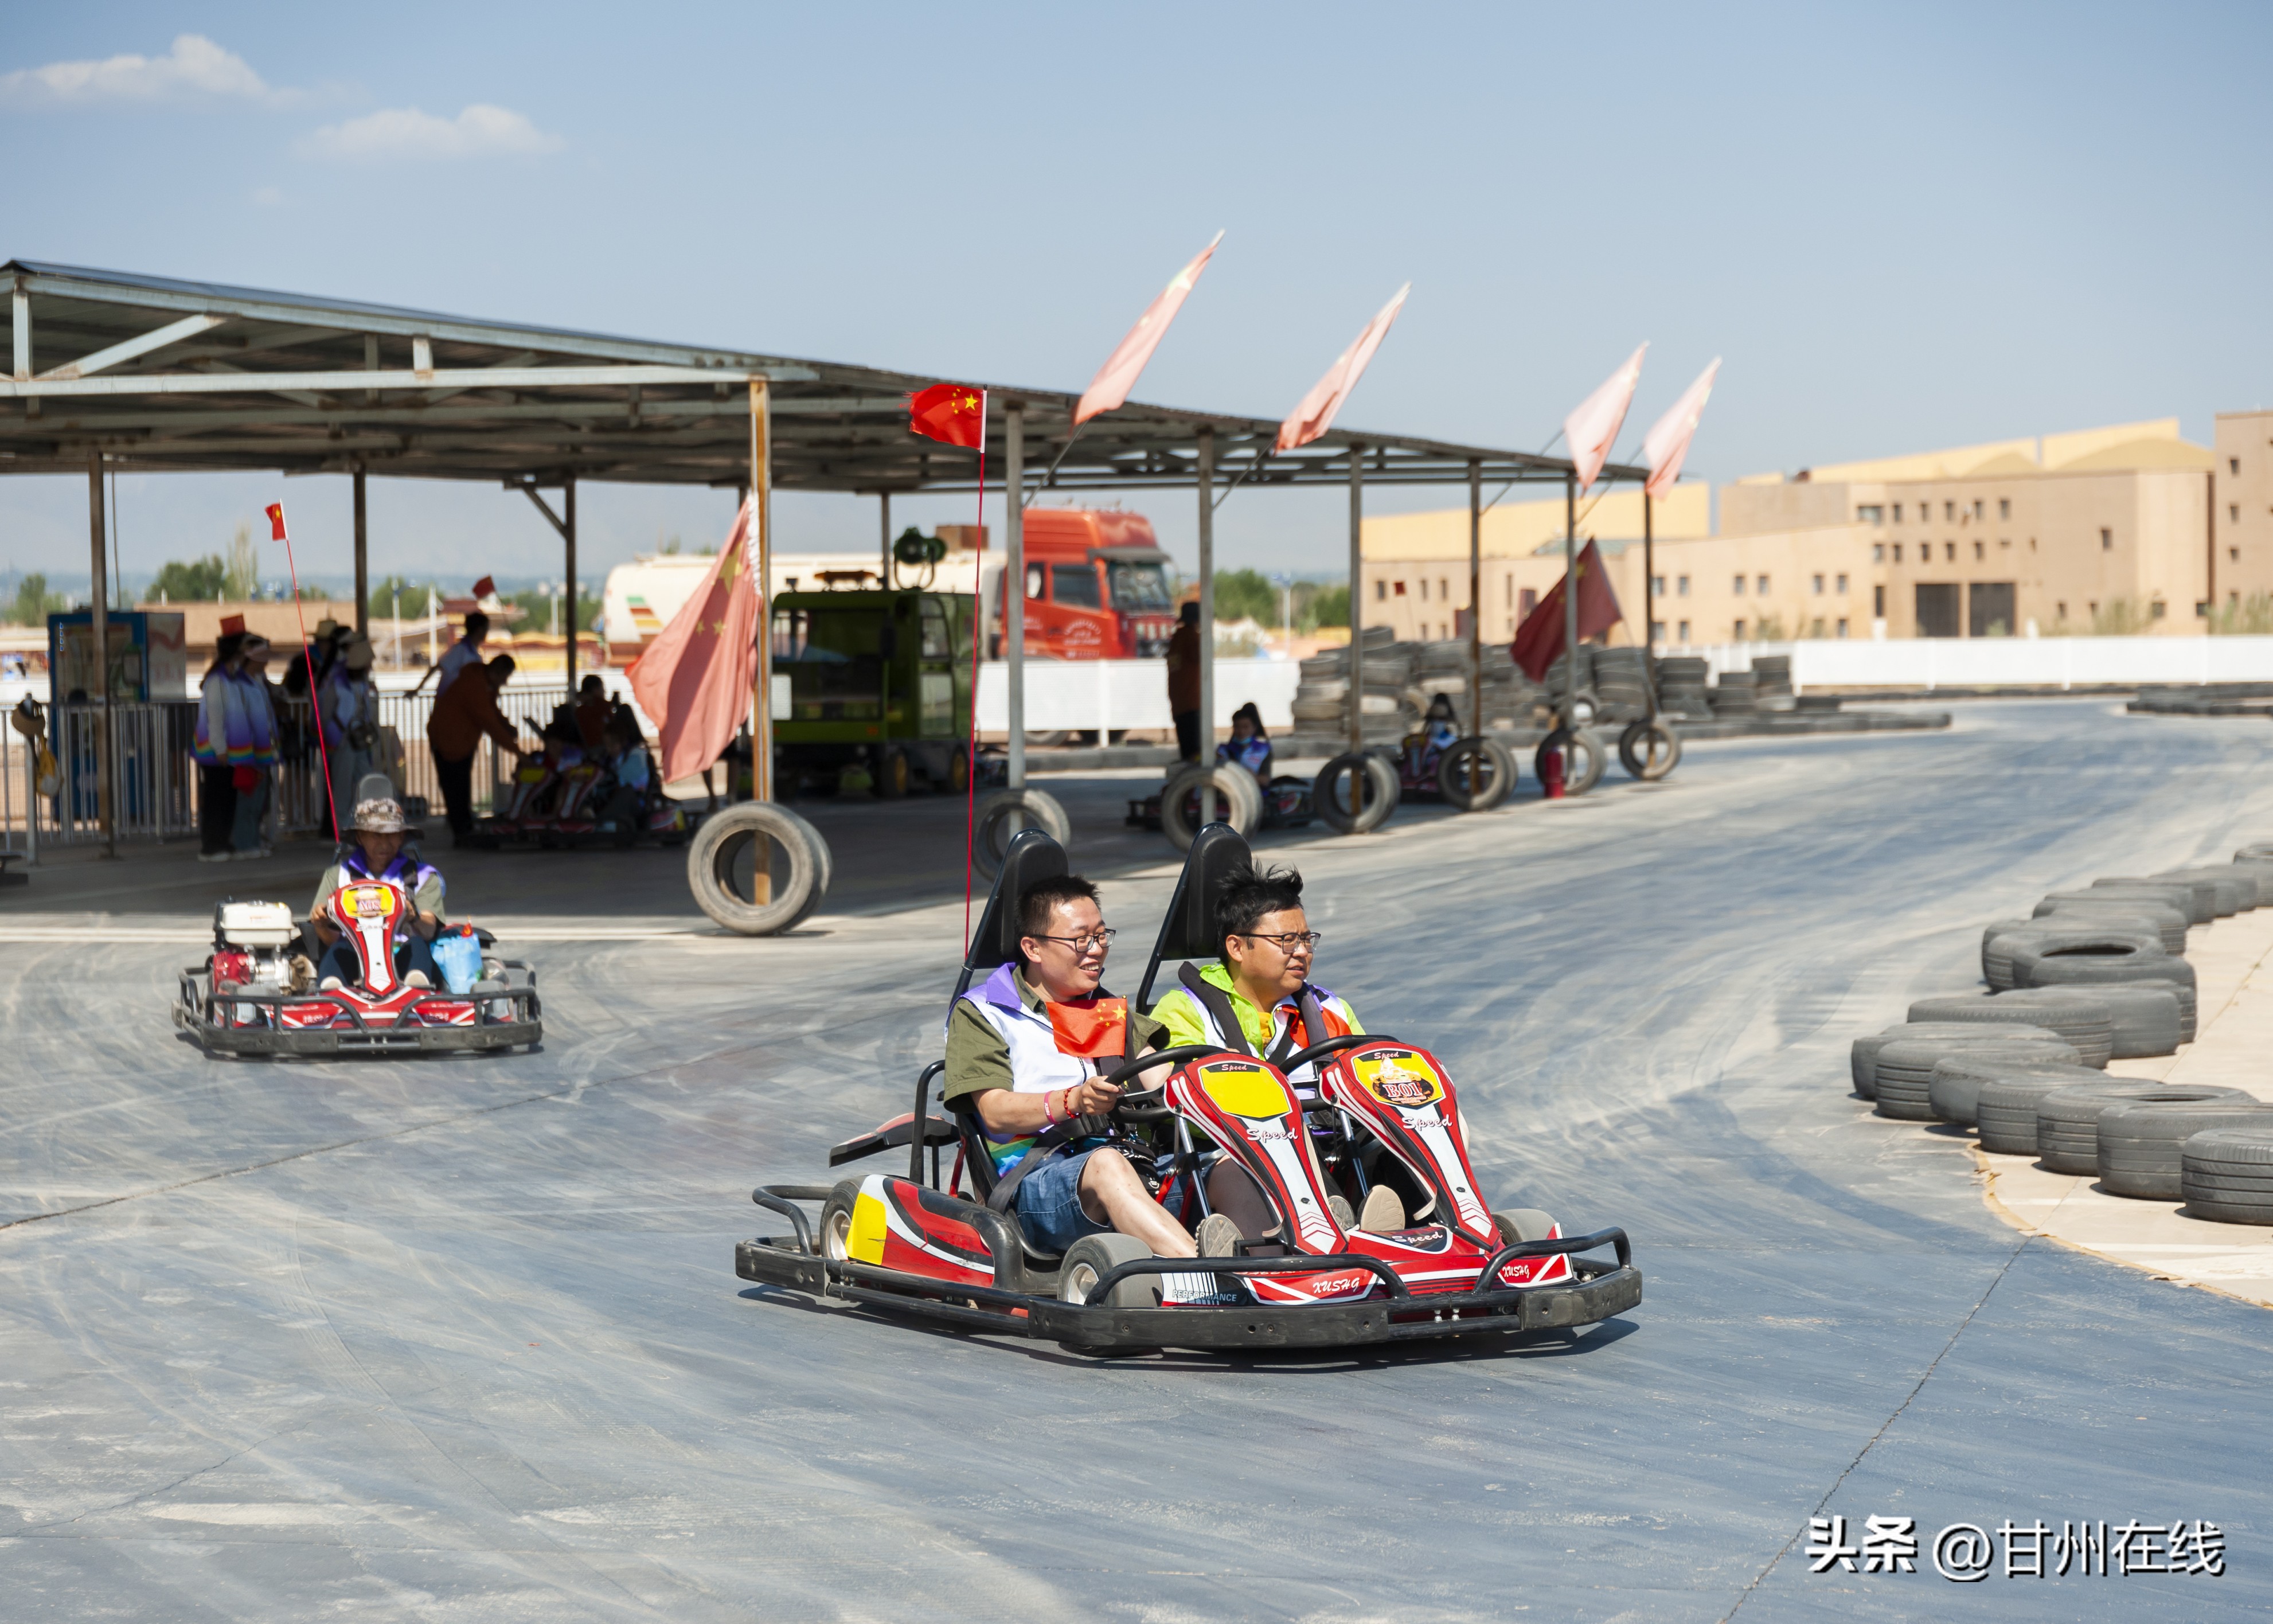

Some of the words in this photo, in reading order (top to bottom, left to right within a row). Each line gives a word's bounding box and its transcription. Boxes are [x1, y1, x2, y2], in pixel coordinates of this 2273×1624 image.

[1374, 1051, 1400, 1060] Speed
[1401, 1114, 1453, 1131] Speed
[1246, 1127, 1298, 1143] Speed
[1392, 1231, 1443, 1244] Speed
[1172, 1289, 1237, 1302] PERFORMANCE
